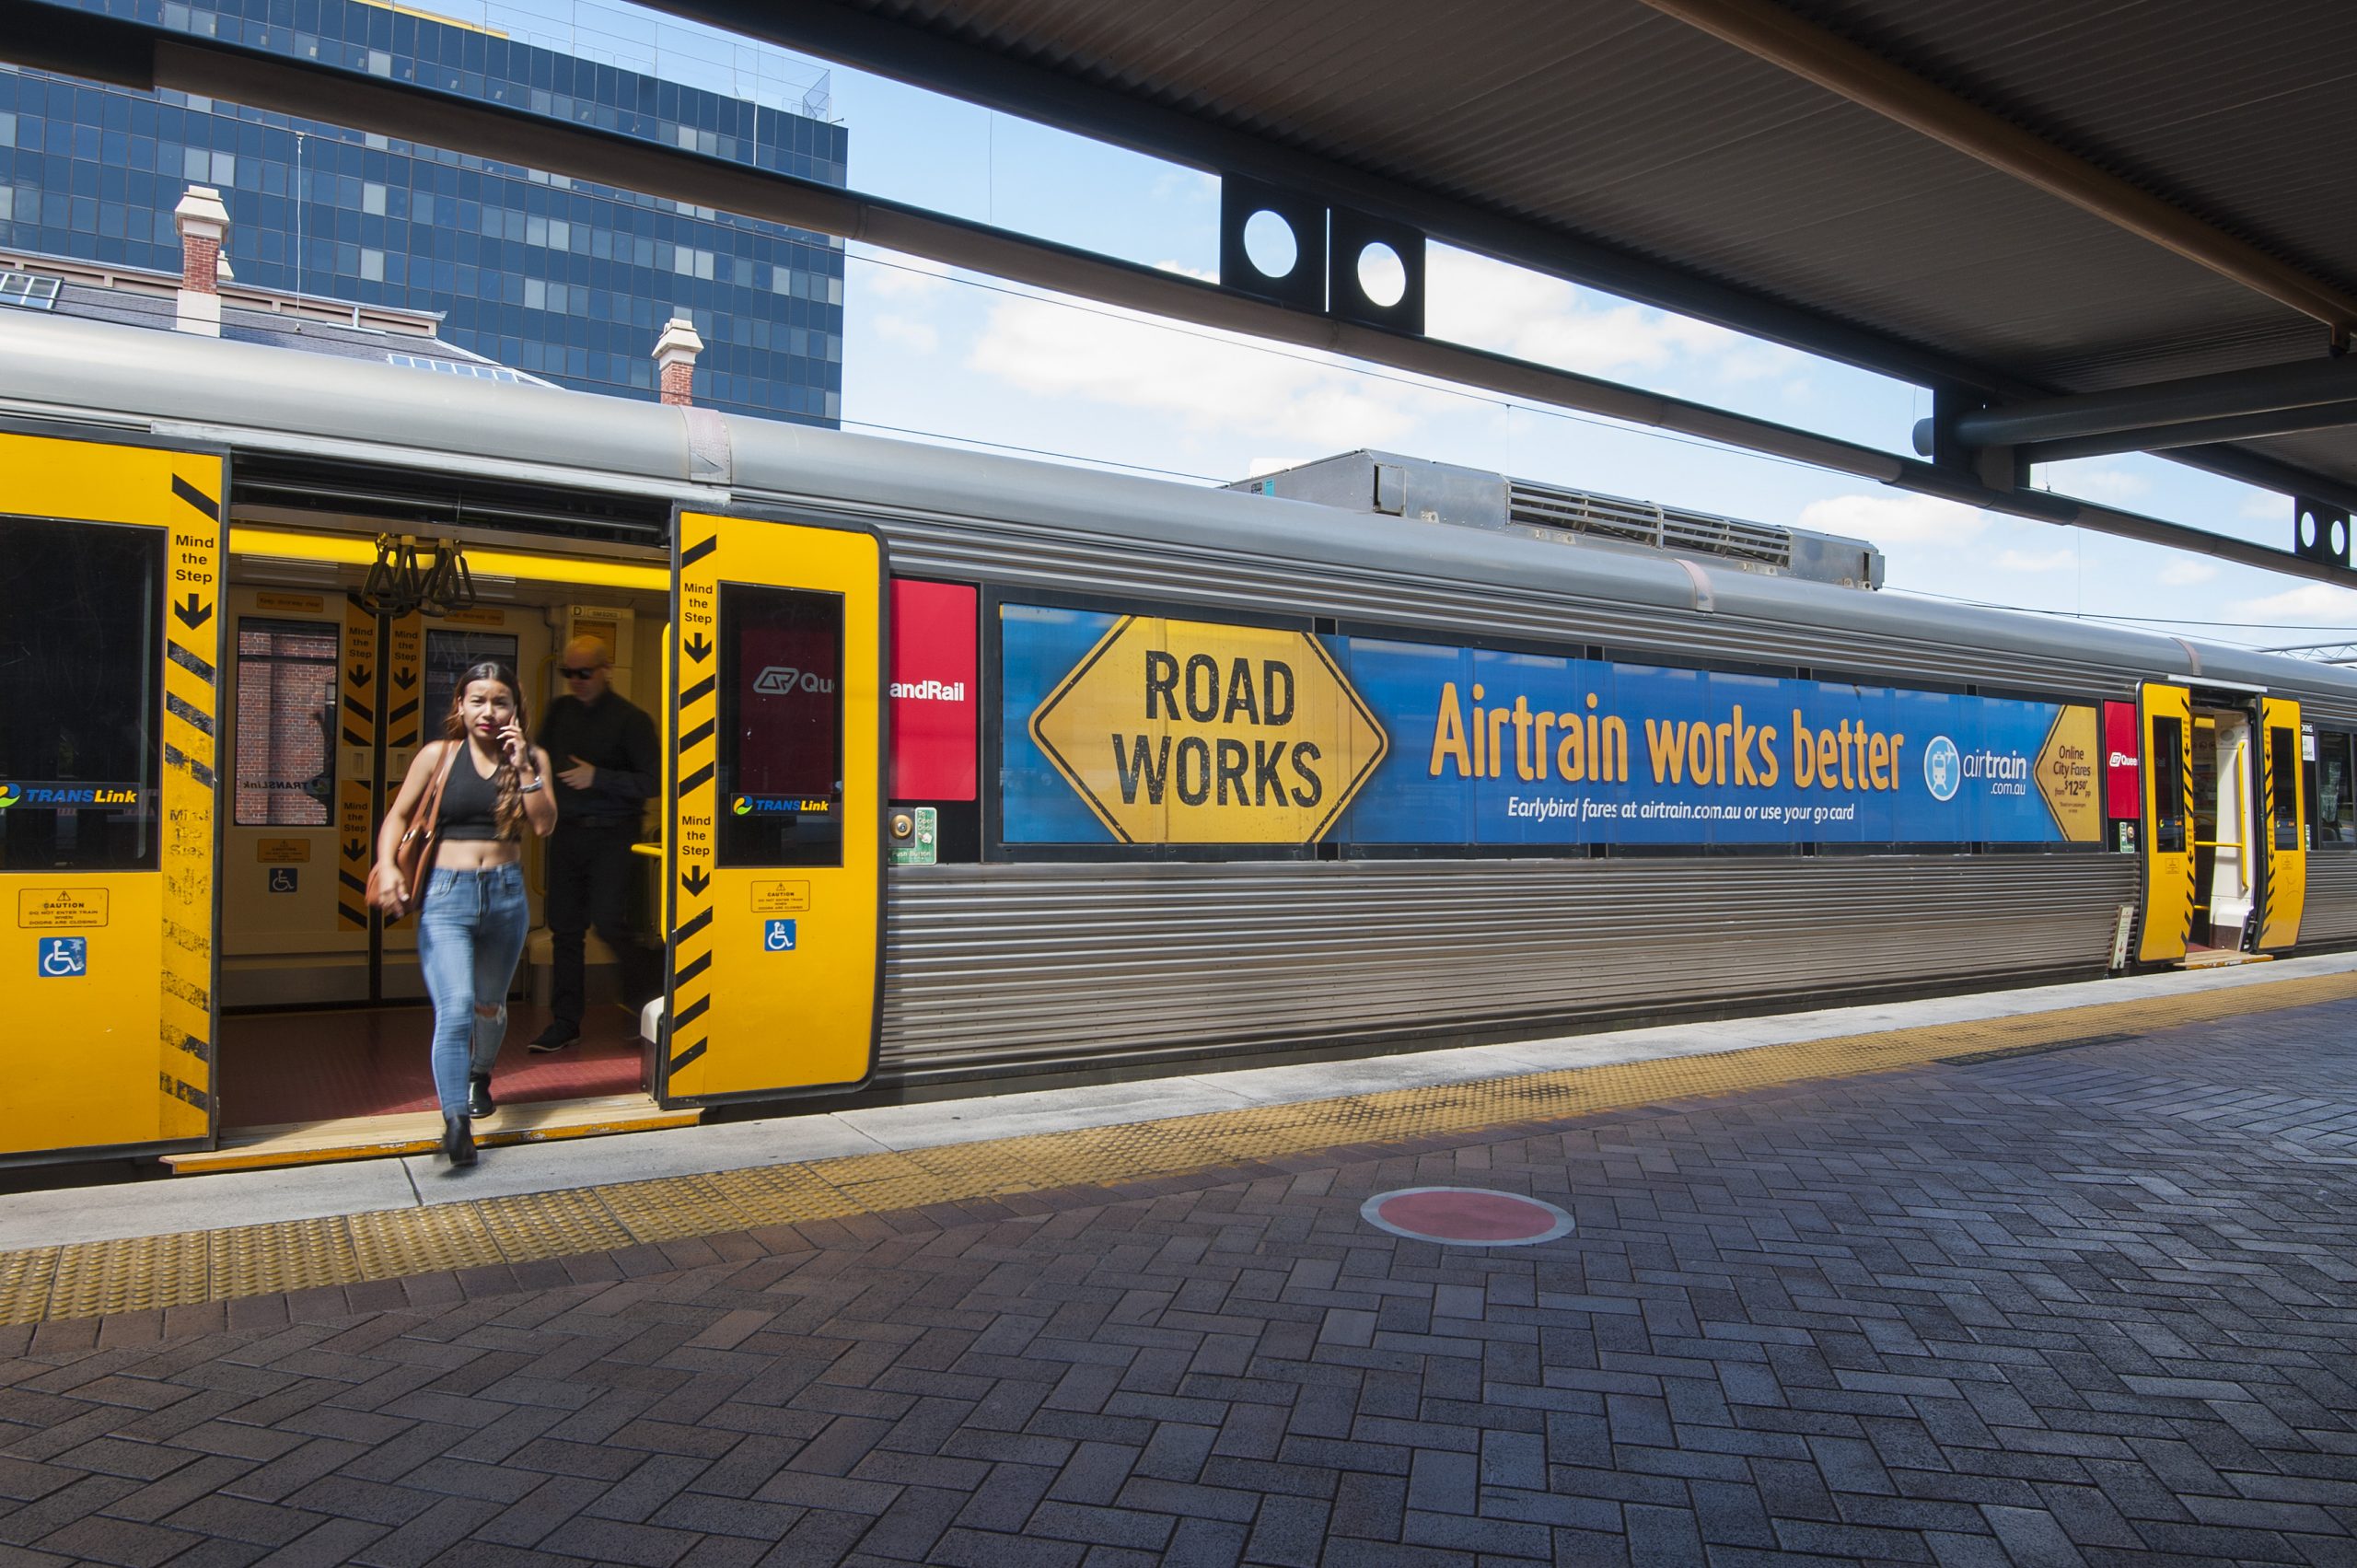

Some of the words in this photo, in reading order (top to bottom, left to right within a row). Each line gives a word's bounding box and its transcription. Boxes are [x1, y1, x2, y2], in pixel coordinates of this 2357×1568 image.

[175, 534, 215, 549] Mind
[181, 552, 208, 565] the
[175, 568, 213, 586] Step
[684, 582, 713, 595] Mind
[689, 598, 709, 609] the
[574, 607, 583, 616] D
[684, 611, 713, 626] Step
[349, 627, 374, 636] Mind
[394, 630, 419, 640] Mind
[353, 638, 369, 647] the
[398, 641, 413, 650] the
[349, 648, 373, 659] Step
[394, 651, 417, 662] Step
[800, 672, 834, 693] Qu
[1145, 649, 1295, 726] ROAD
[1429, 681, 1628, 783] Airtrain
[1644, 704, 1780, 788] works
[1792, 708, 1905, 791] better
[2060, 746, 2084, 760] Online
[1110, 733, 1323, 808] WORKS
[1962, 749, 2027, 781] airtrain
[2053, 761, 2070, 779] City
[2071, 762, 2091, 776] Fares
[1990, 782, 2026, 796] .com.au
[25, 788, 138, 804] TRANSLink
[344, 802, 368, 810] Mind
[755, 799, 830, 812] TRANSLink
[1507, 796, 1579, 823] Earlybird
[1581, 797, 1618, 823] fares
[1620, 801, 1638, 819] at
[1640, 800, 1741, 819] airtrain.com.au
[1744, 806, 1759, 819] or
[1759, 806, 1782, 820] use
[1782, 806, 1813, 825] your
[1813, 807, 1829, 825] go
[1829, 803, 1855, 820] card
[347, 813, 365, 822] the
[681, 815, 712, 826] Mind
[343, 823, 367, 833] Step
[686, 830, 707, 841] the
[681, 845, 711, 858] Step
